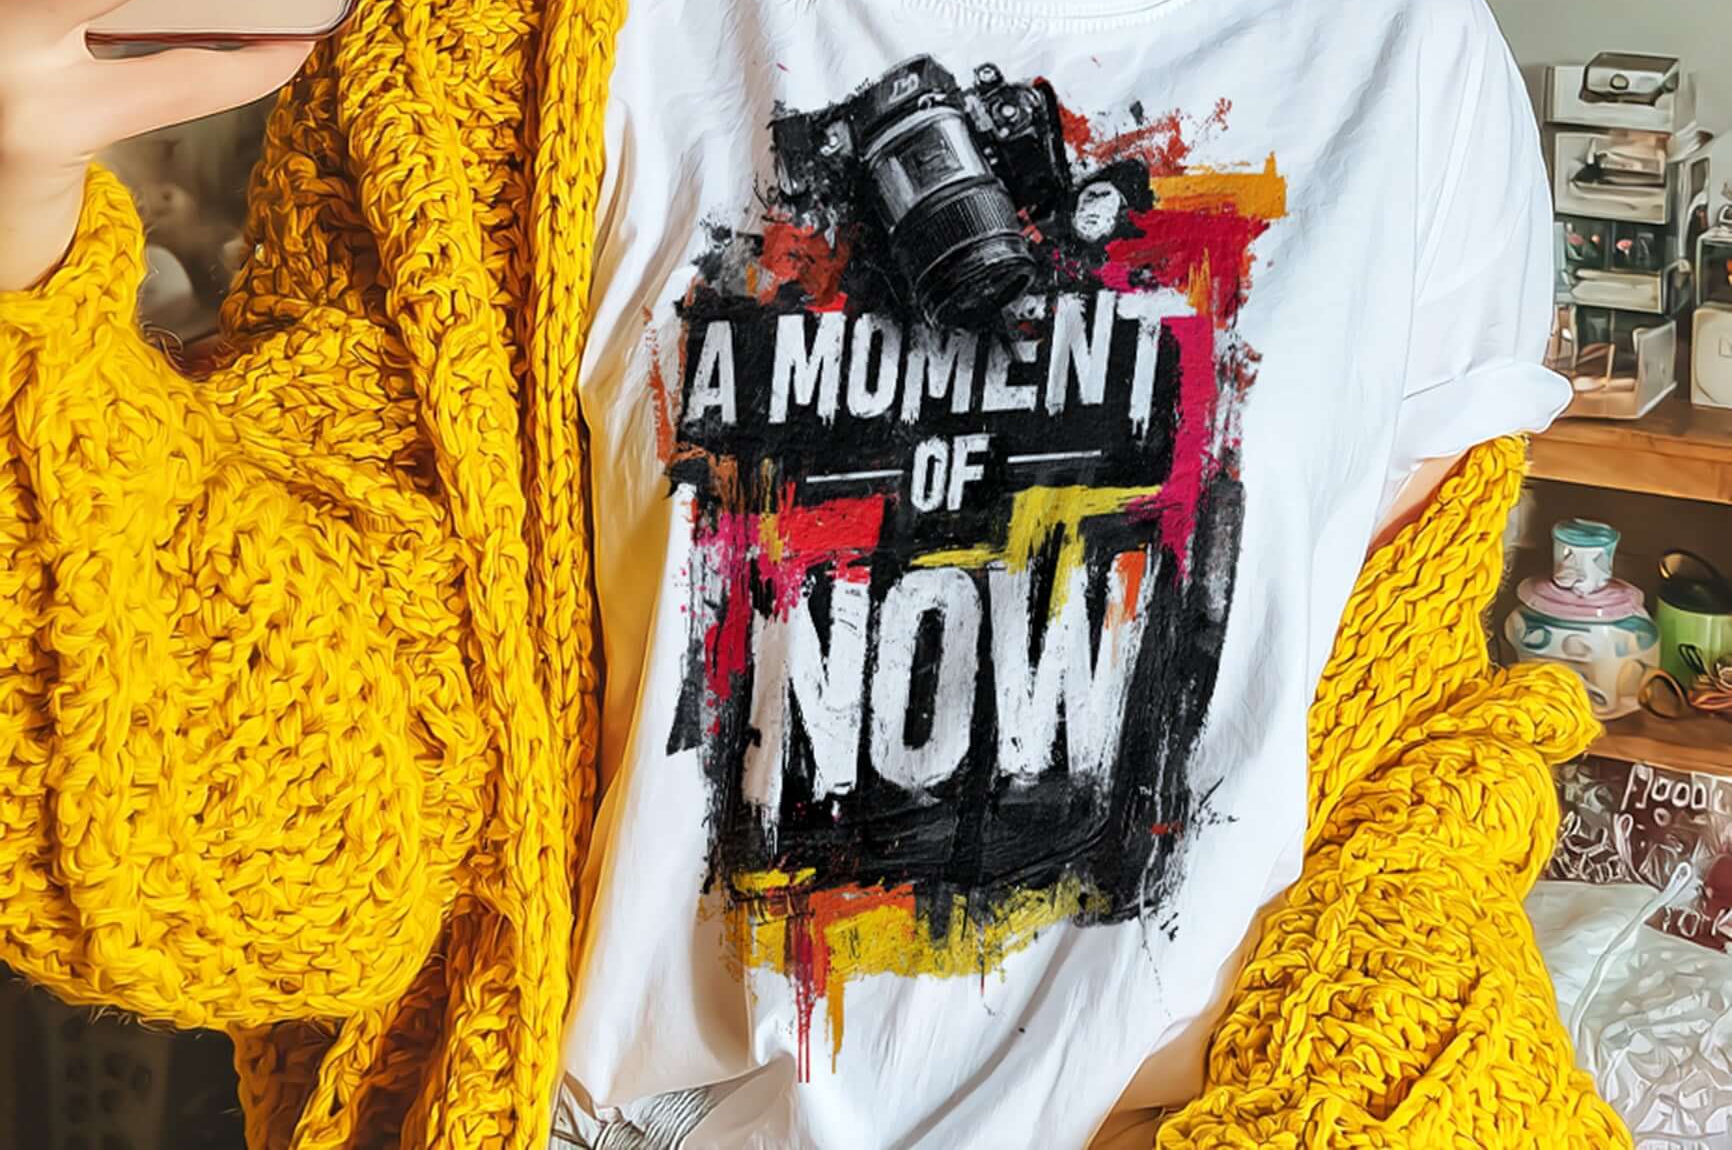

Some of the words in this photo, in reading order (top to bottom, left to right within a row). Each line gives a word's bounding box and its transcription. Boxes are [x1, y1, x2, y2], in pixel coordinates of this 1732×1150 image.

[684, 319, 738, 425] A
[768, 288, 1198, 438] MOMENT
[910, 432, 994, 514] OF
[742, 548, 1156, 816] NOW
